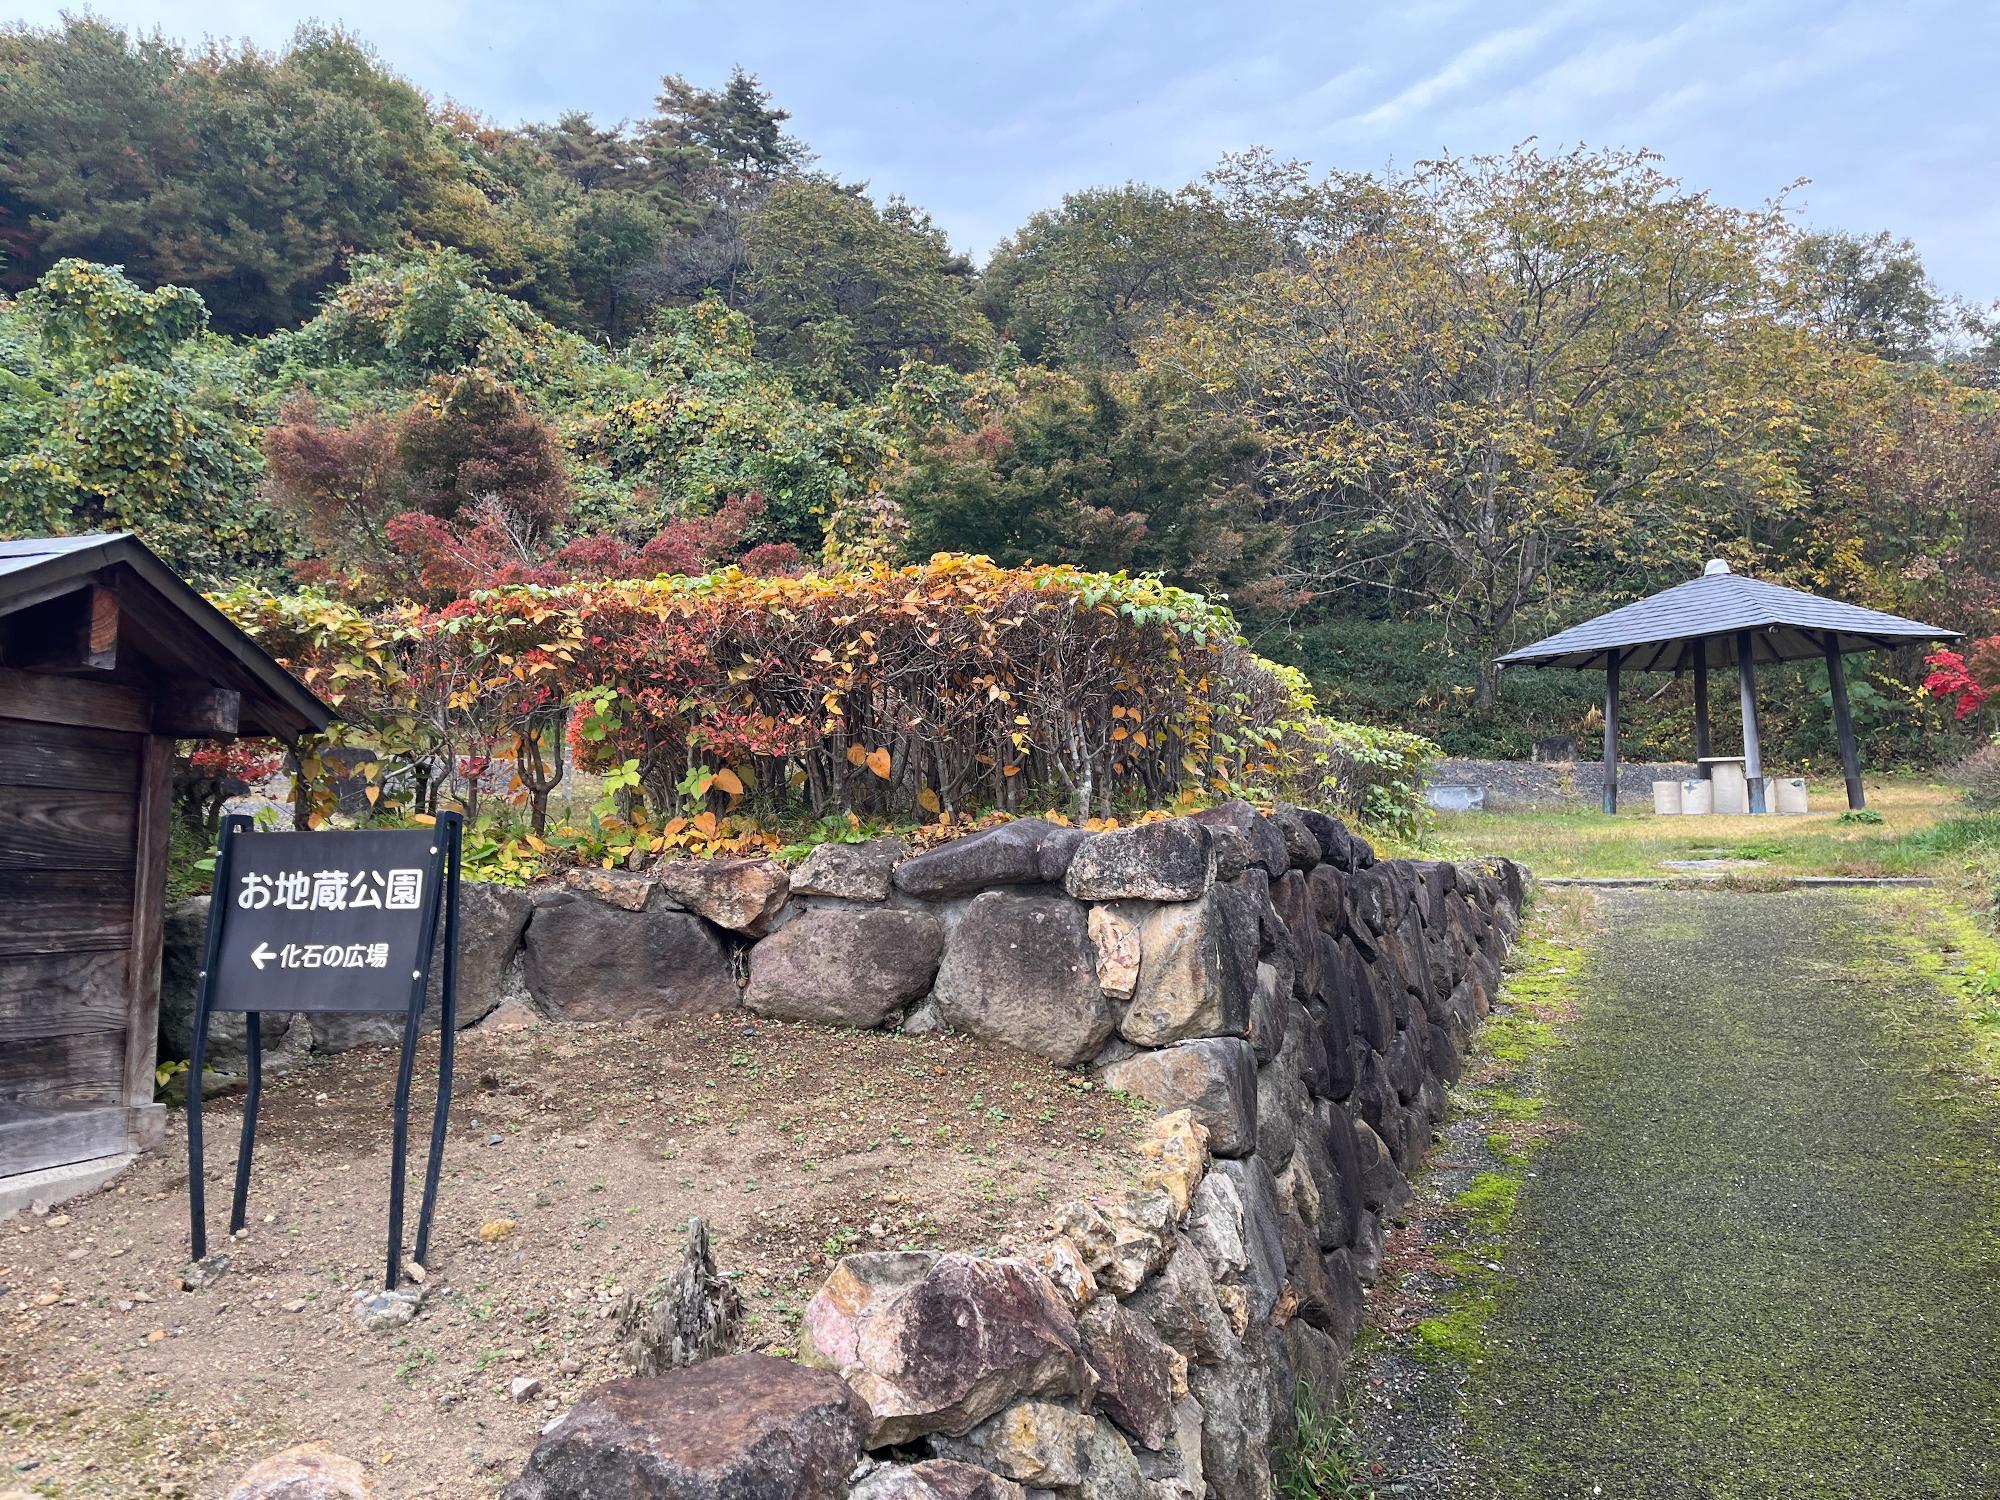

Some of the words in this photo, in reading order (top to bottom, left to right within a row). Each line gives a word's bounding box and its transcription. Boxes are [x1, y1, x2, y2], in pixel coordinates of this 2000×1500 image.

[238, 868, 423, 911] お地蔵公園
[280, 943, 389, 968] 化石の広場
